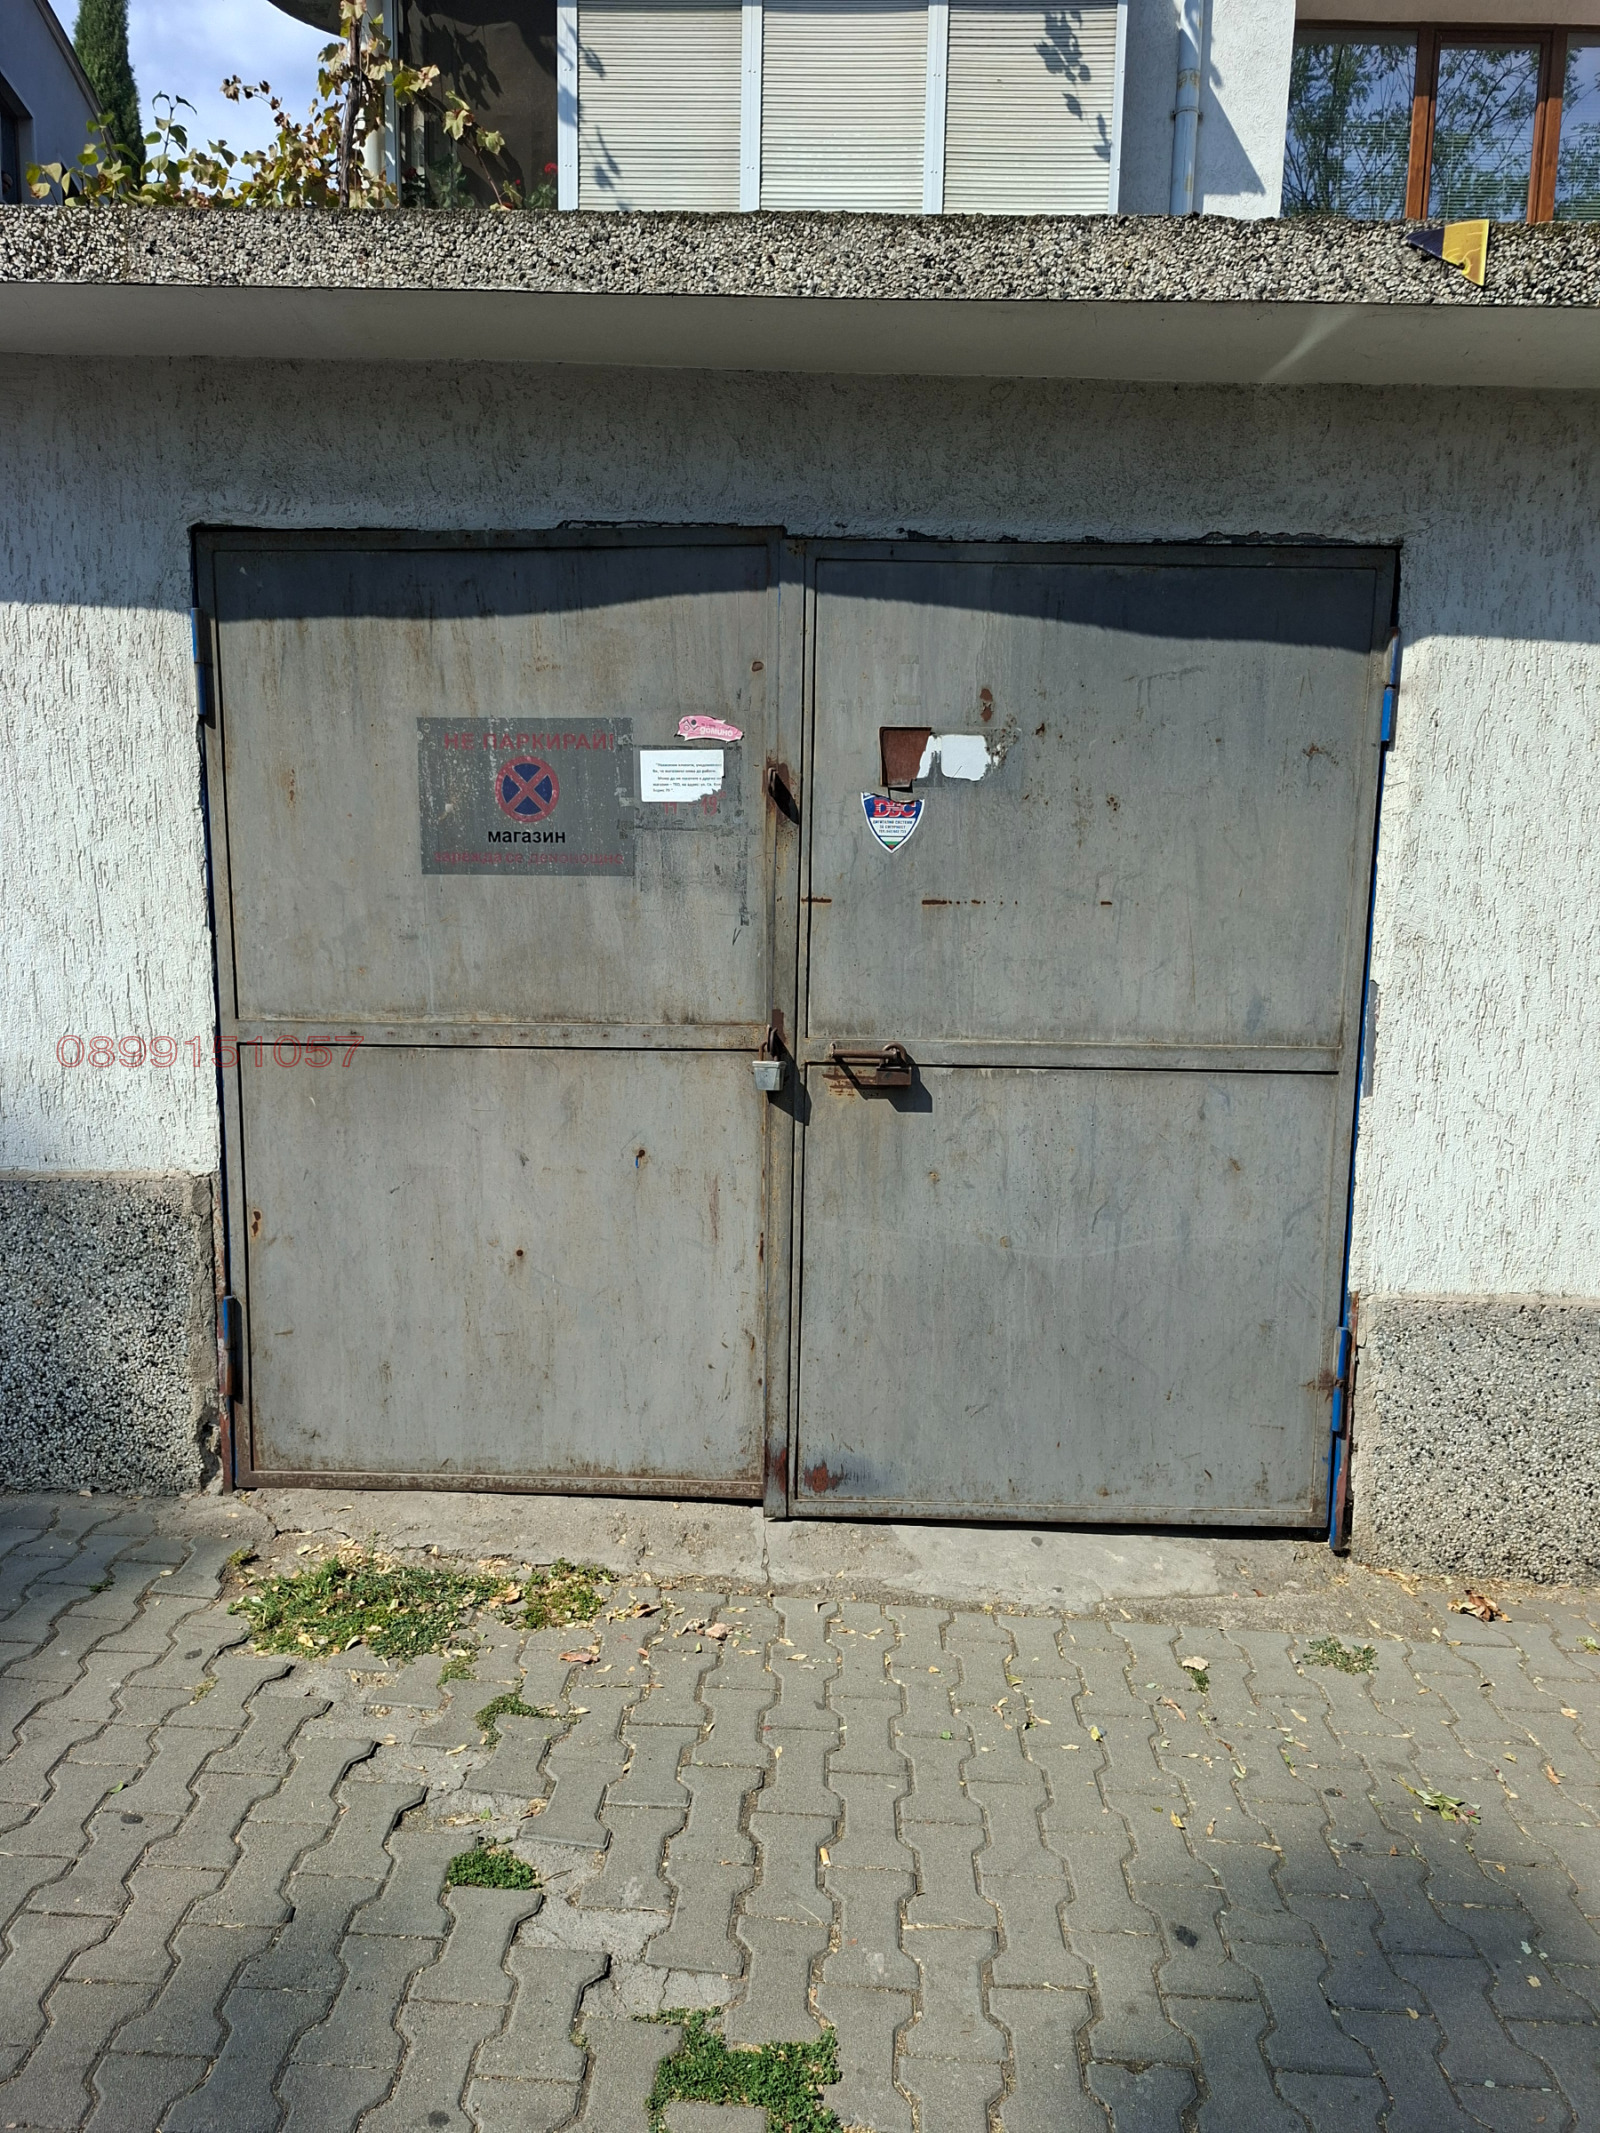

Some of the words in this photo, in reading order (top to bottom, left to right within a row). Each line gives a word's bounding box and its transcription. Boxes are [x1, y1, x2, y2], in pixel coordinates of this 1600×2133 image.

[443, 731, 475, 751] НЕ
[483, 729, 615, 751] ПАРКИРАЙ!
[487, 830, 567, 844] магазин
[505, 852, 523, 865] се
